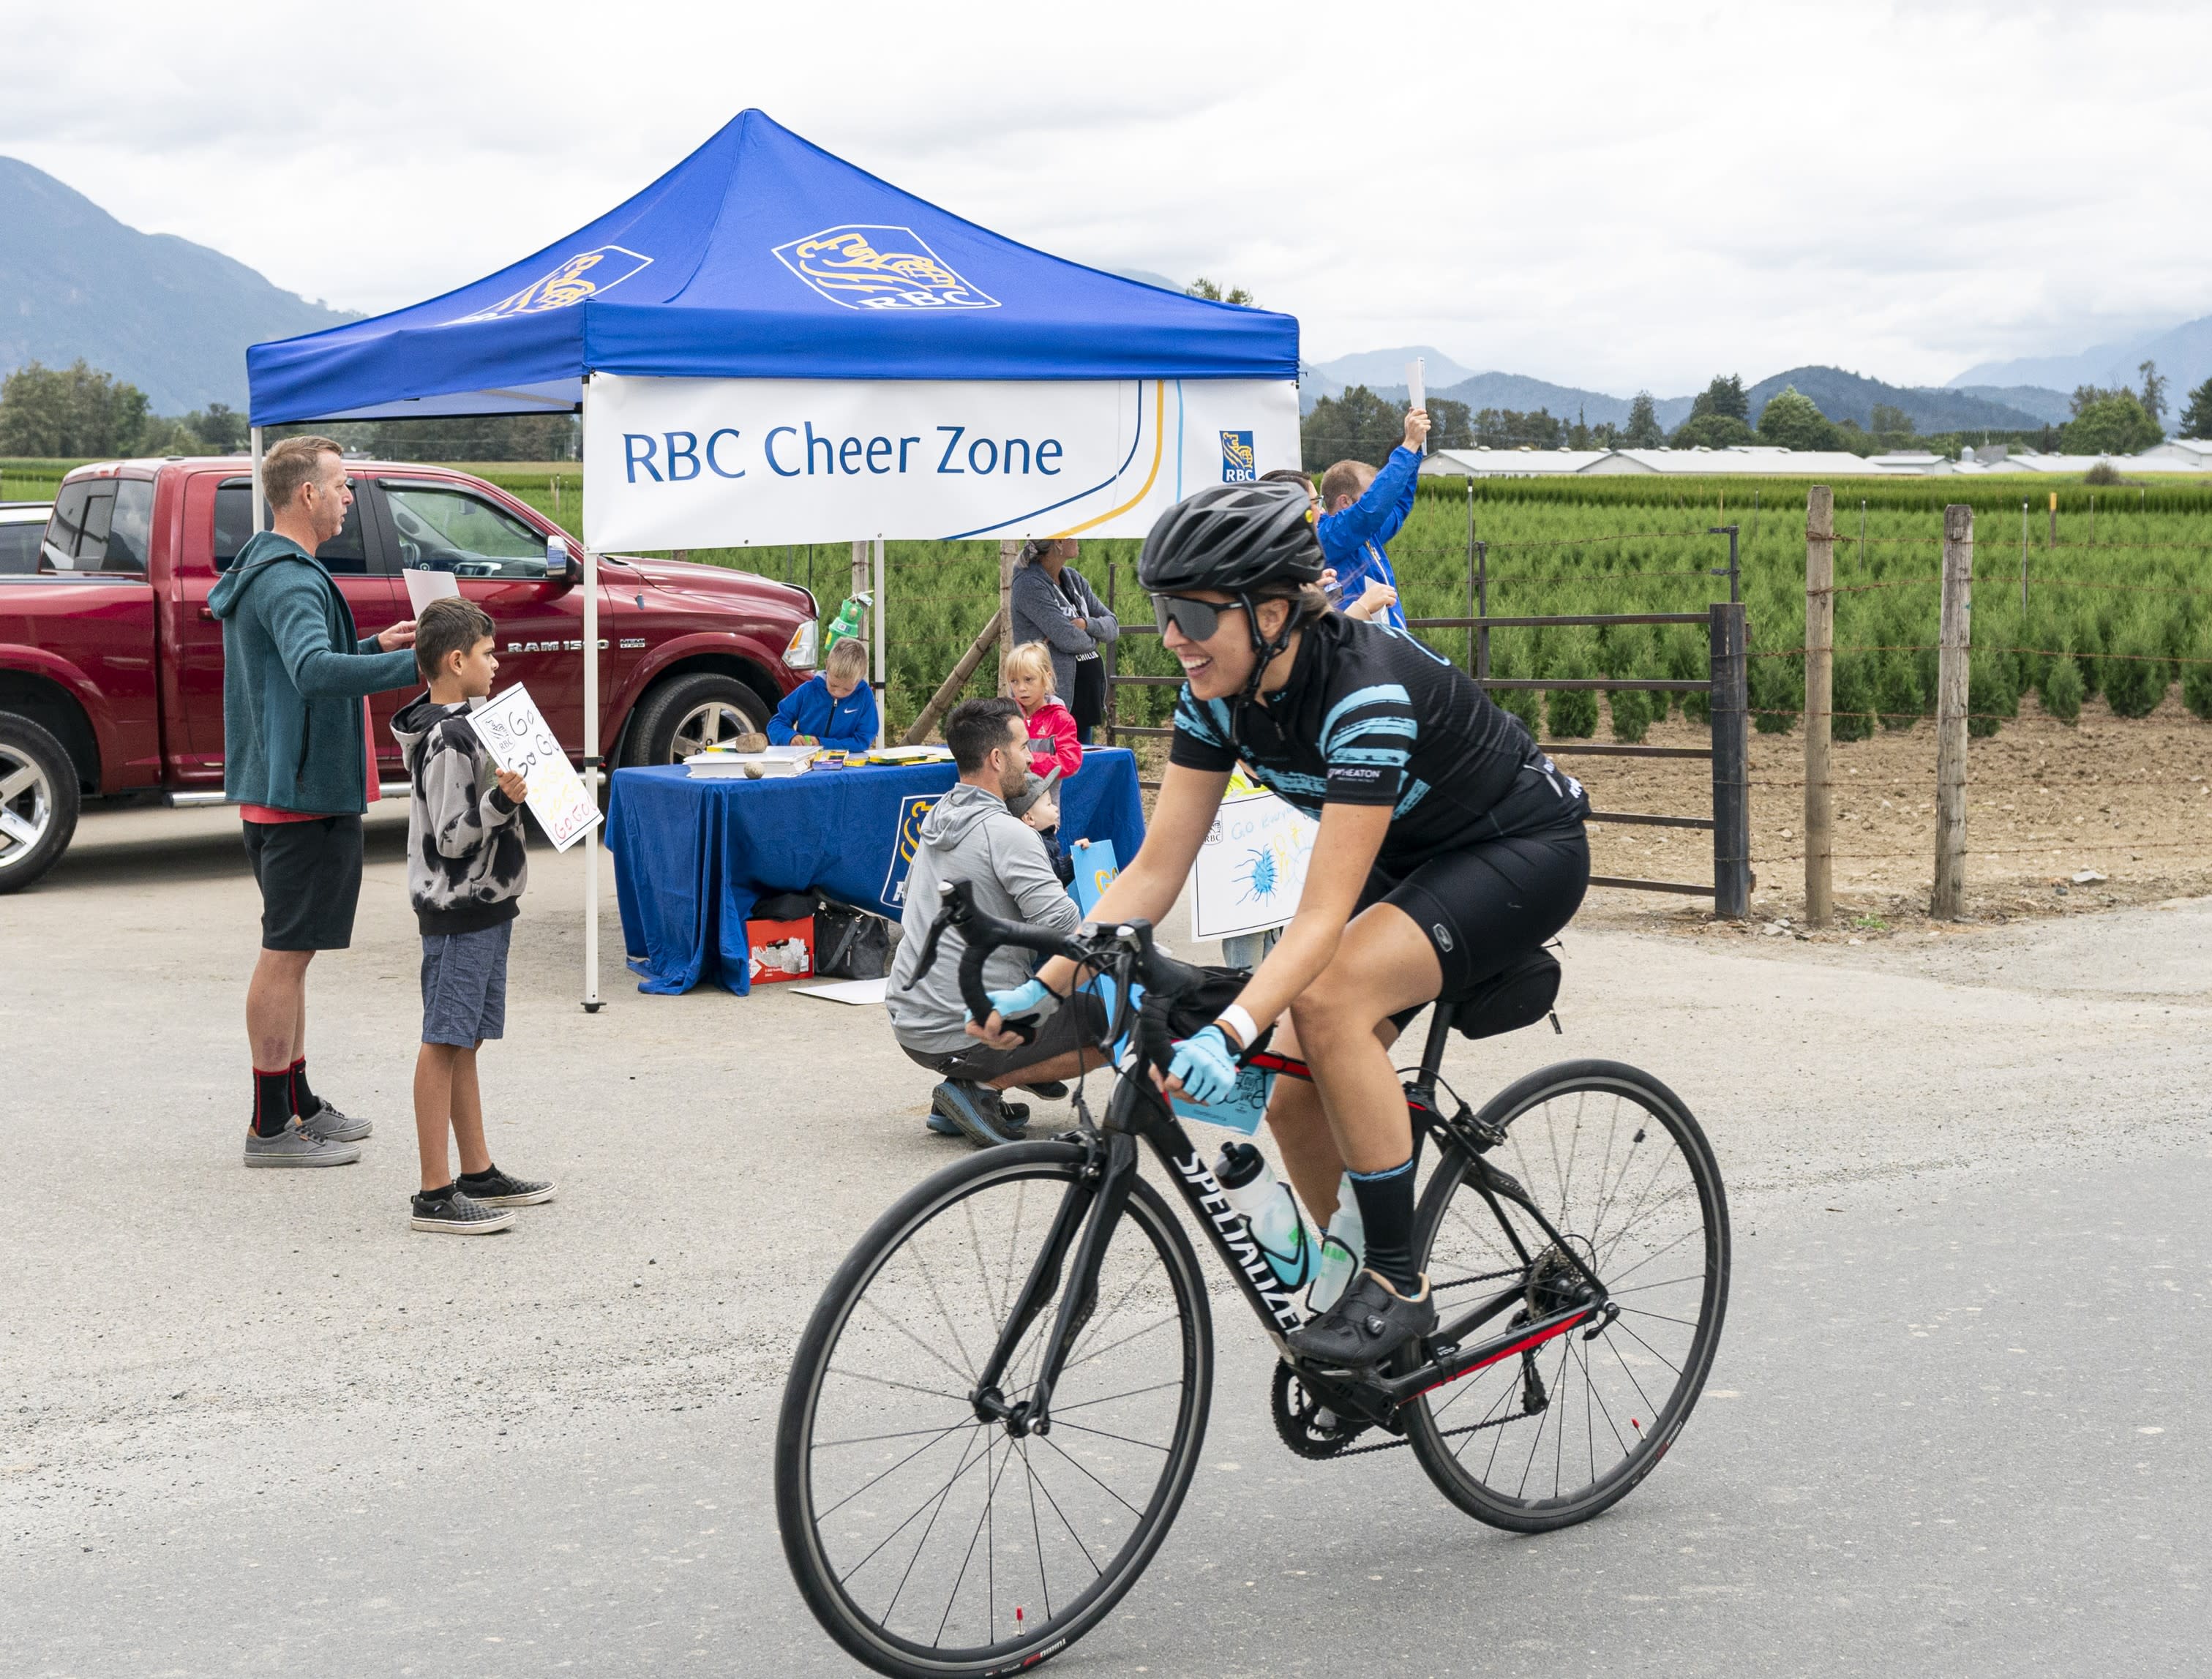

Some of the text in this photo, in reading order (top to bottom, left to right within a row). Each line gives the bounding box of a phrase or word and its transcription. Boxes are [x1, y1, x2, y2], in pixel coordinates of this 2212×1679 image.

[857, 291, 986, 309] RBC
[622, 421, 1063, 484] RBC Cheer Zone
[1226, 469, 1254, 481] RBC
[508, 639, 610, 653] RAM 150
[499, 737, 515, 751] RBC
[1204, 833, 1221, 843] RBC
[1172, 1152, 1306, 1334] SPECIALIZE
